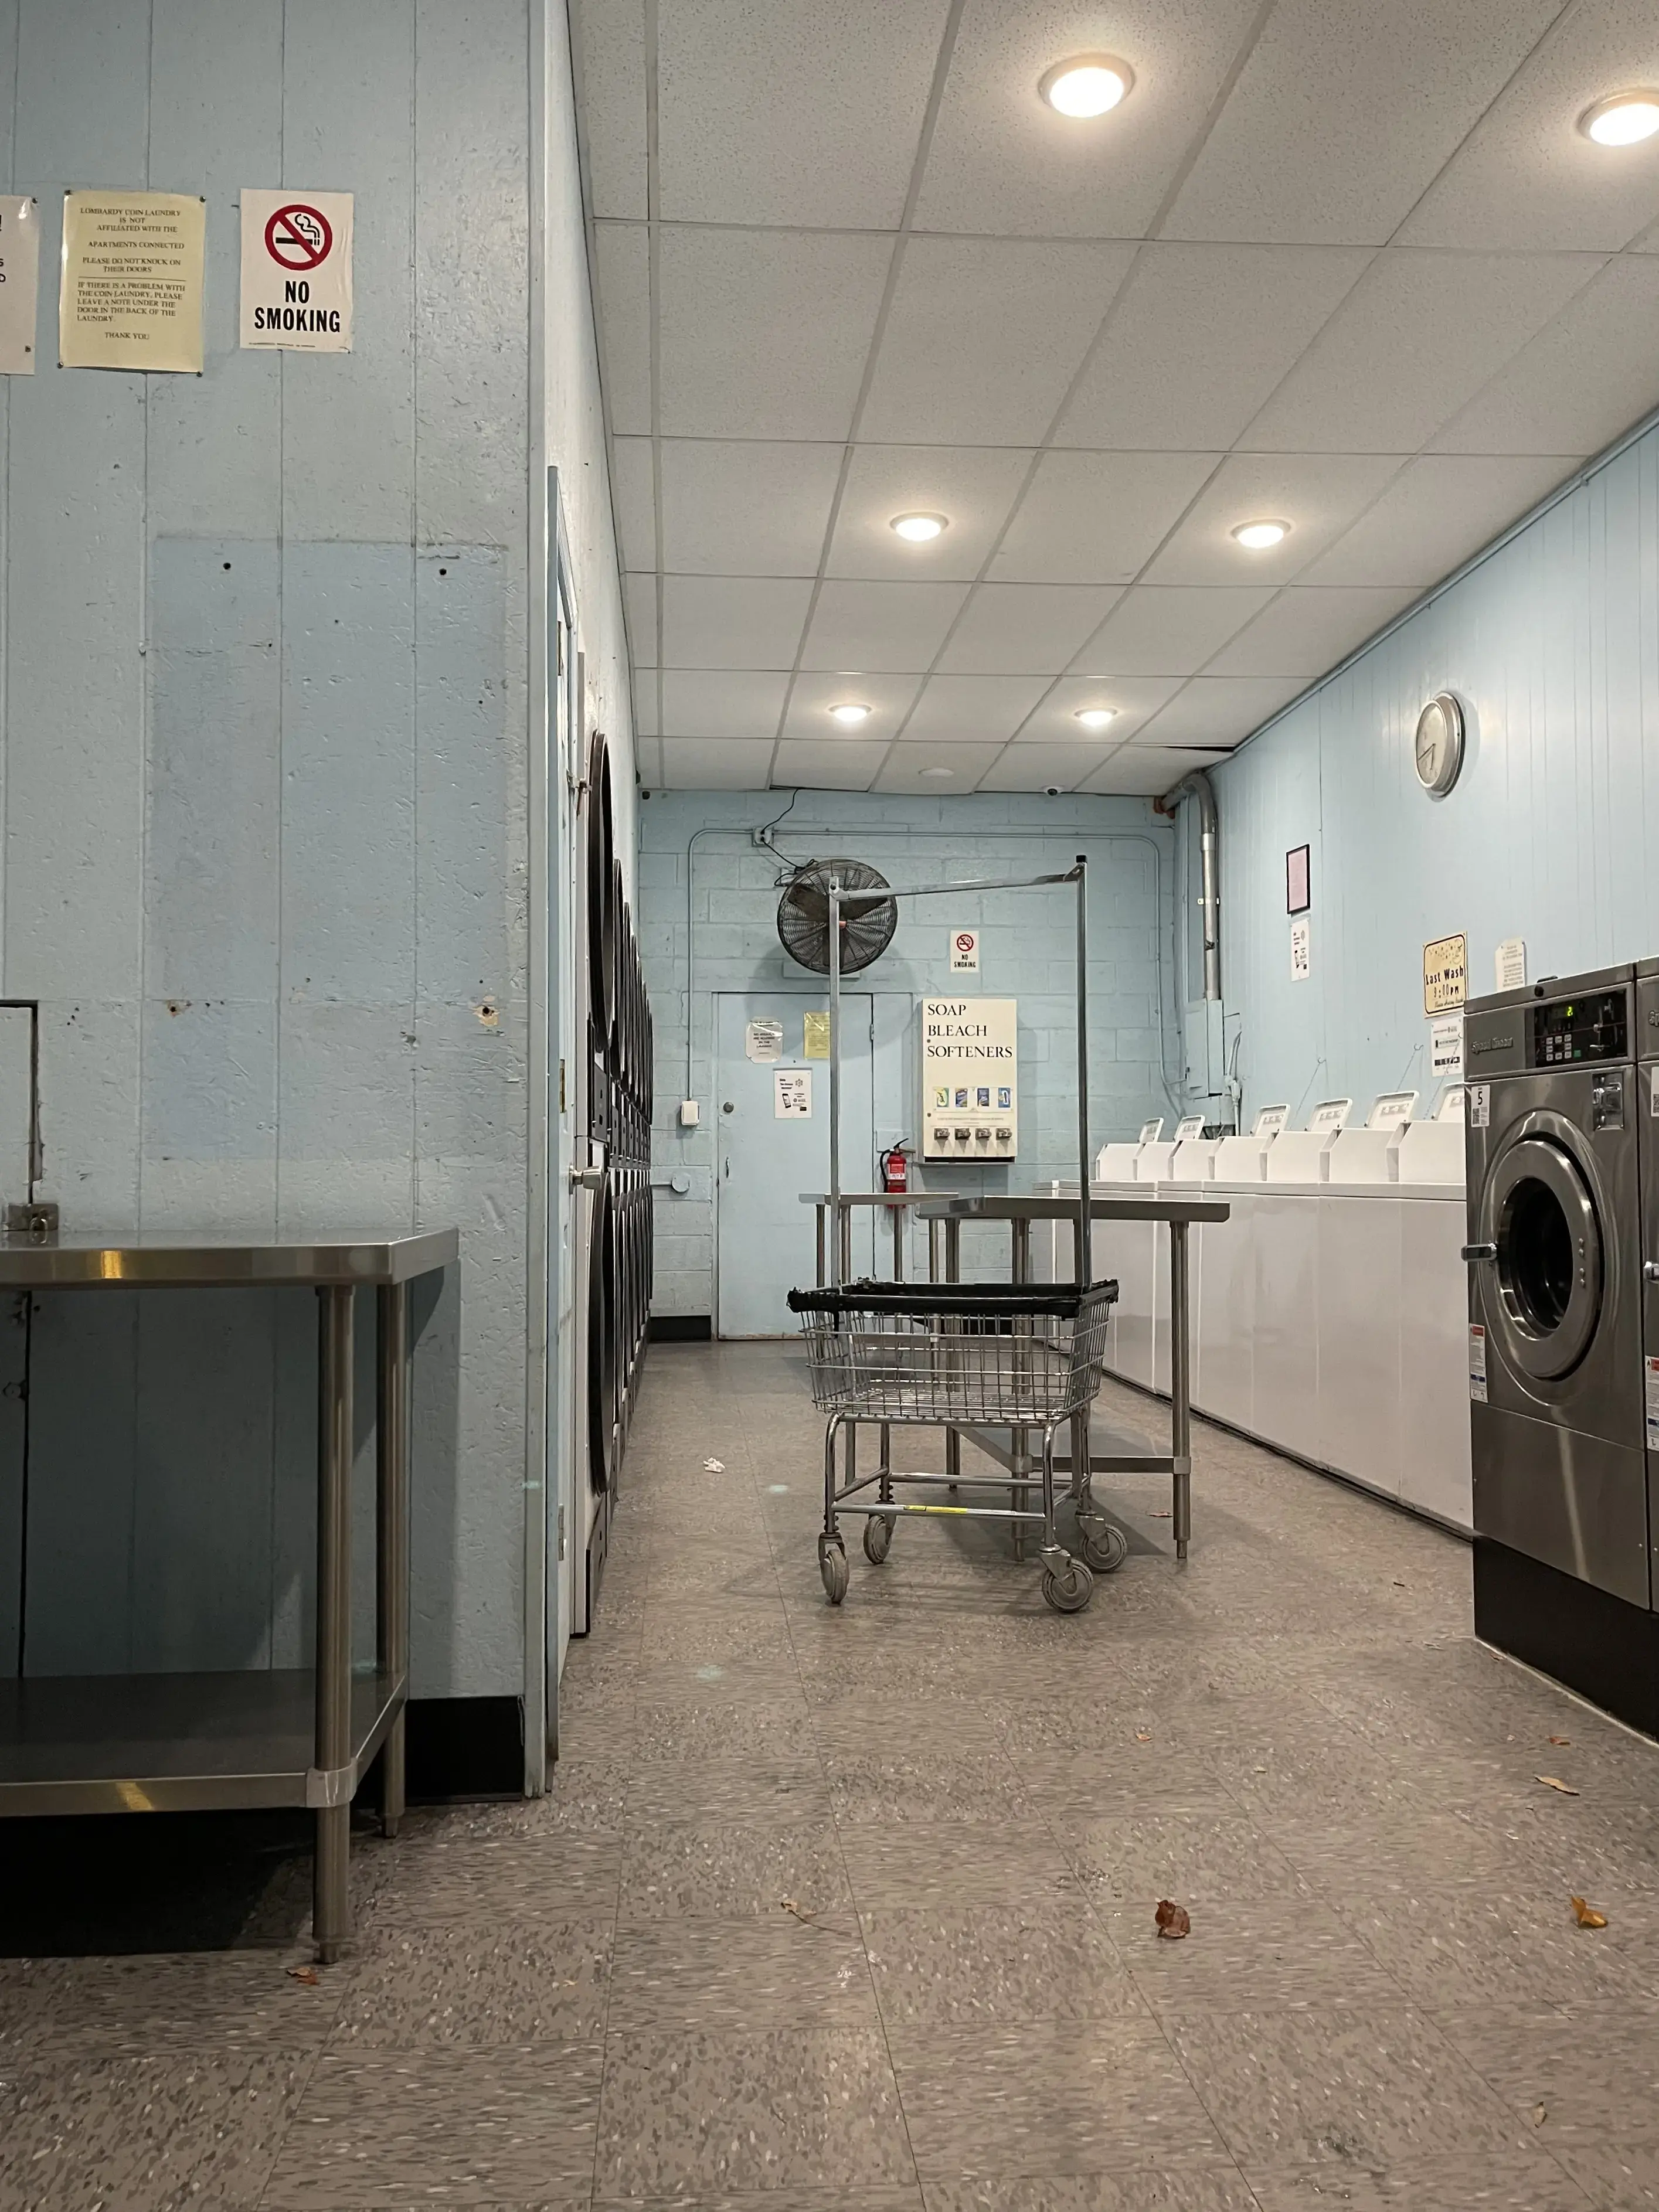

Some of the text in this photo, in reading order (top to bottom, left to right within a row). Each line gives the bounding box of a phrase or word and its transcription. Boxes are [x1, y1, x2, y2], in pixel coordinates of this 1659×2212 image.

[128, 283, 164, 291] PROBLEM
[285, 281, 310, 304] NO
[154, 292, 182, 300] PLEASE
[254, 307, 340, 332] SMOKING
[1426, 965, 1464, 985] Last Wash
[927, 1004, 966, 1016] SOAP
[928, 1025, 987, 1036] BLEACH
[927, 1046, 1013, 1058] SOFTENERS
[1478, 1091, 1483, 1105] 5
